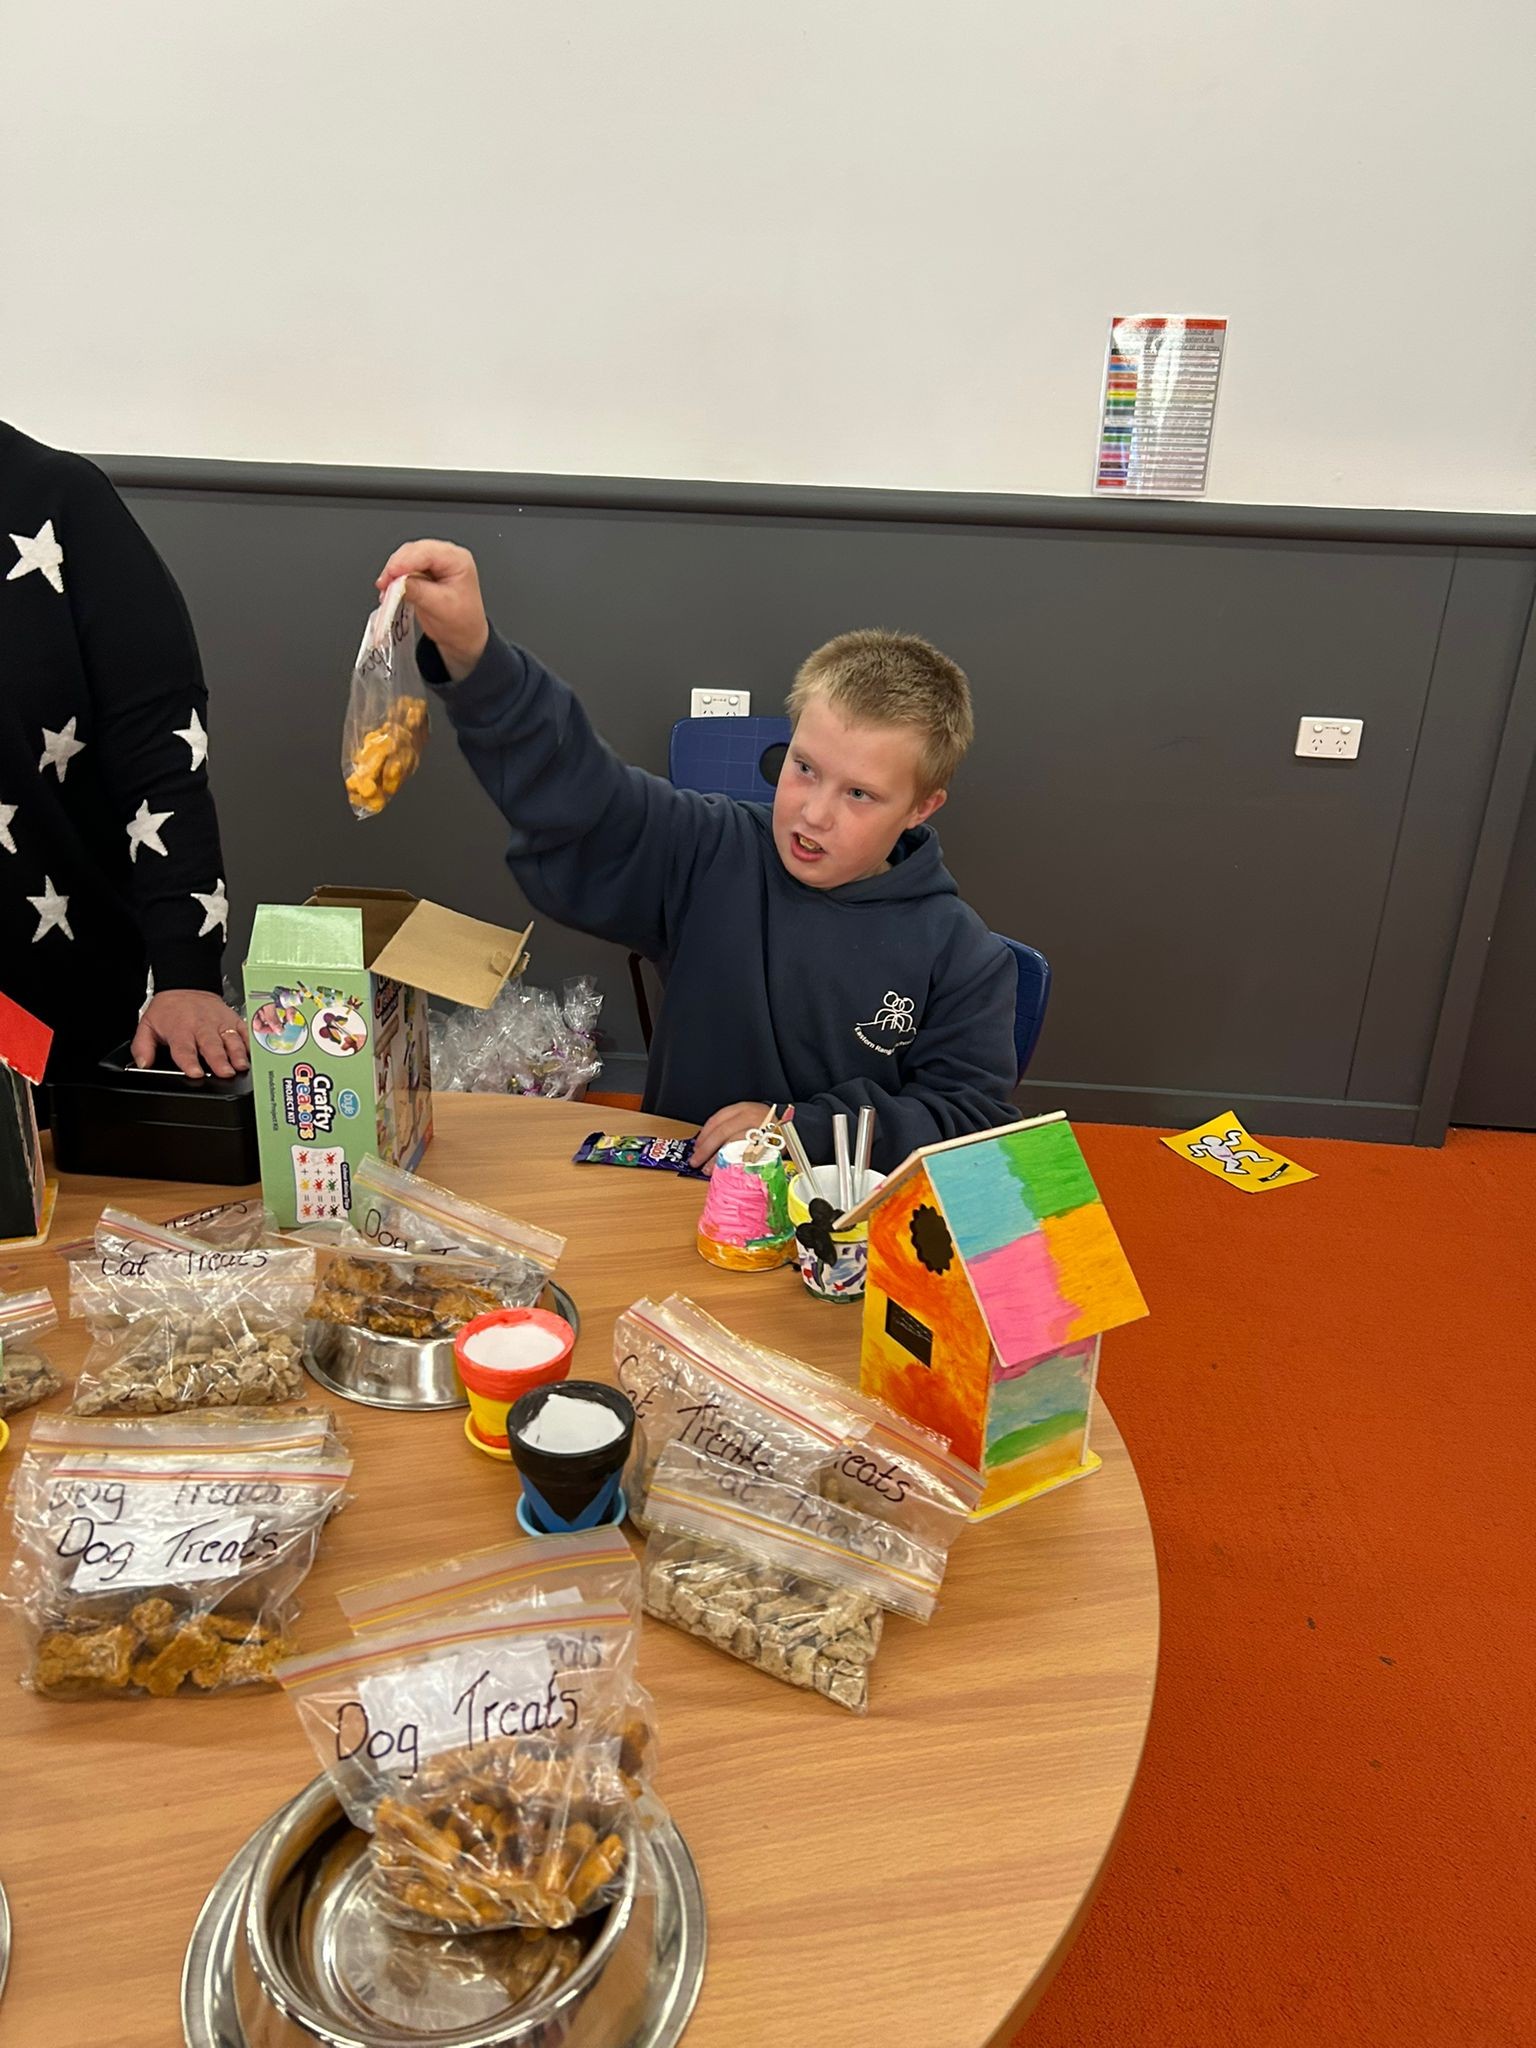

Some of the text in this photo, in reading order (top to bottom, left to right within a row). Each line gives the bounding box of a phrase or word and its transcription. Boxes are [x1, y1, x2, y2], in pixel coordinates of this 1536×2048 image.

[284, 1079, 296, 1124] PROJECT KIT
[295, 1064, 315, 1140] Creators
[313, 1075, 334, 1131] Crafty
[173, 1249, 269, 1275] Treats
[56, 1516, 280, 1581] Dog Treats
[335, 1670, 582, 1779] Dog Treats
